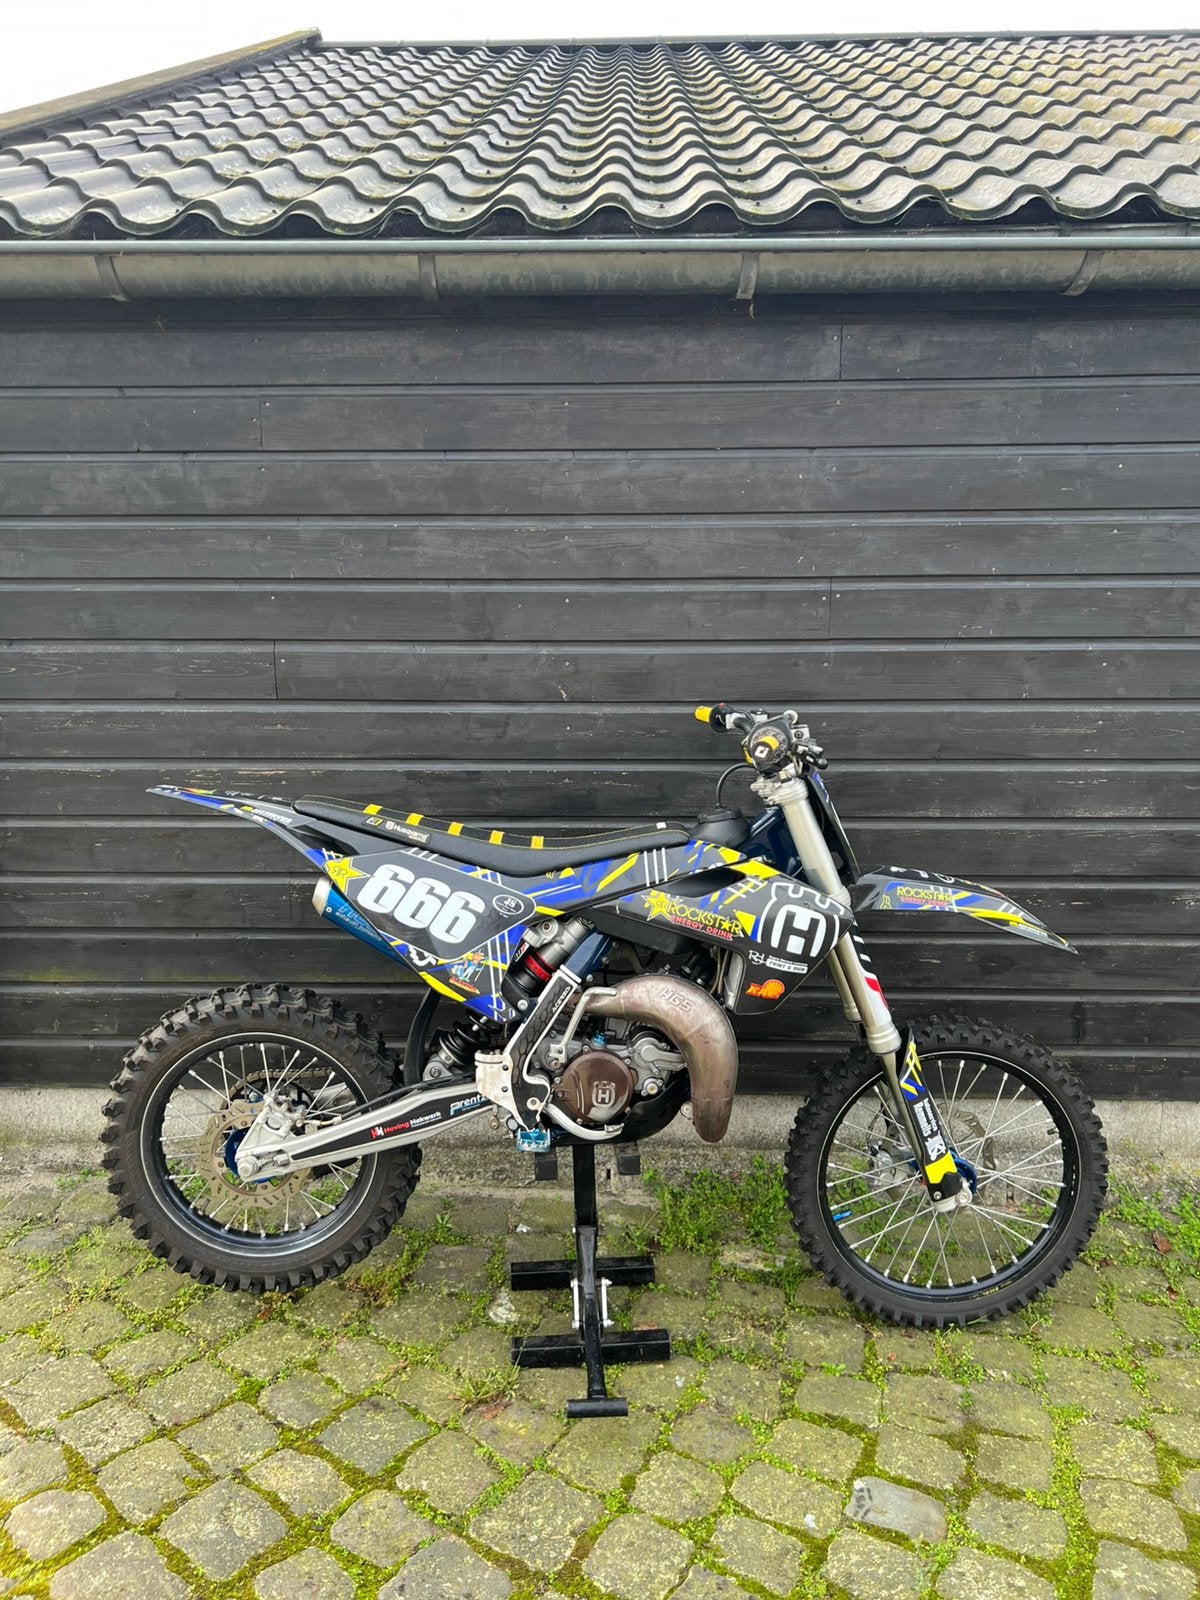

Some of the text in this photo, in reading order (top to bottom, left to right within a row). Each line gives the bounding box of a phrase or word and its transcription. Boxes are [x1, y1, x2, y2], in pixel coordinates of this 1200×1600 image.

[357, 864, 485, 944] 666
[671, 915, 704, 931] ENERGY
[706, 926, 733, 940] DRINK
[658, 988, 696, 1013] HGS
